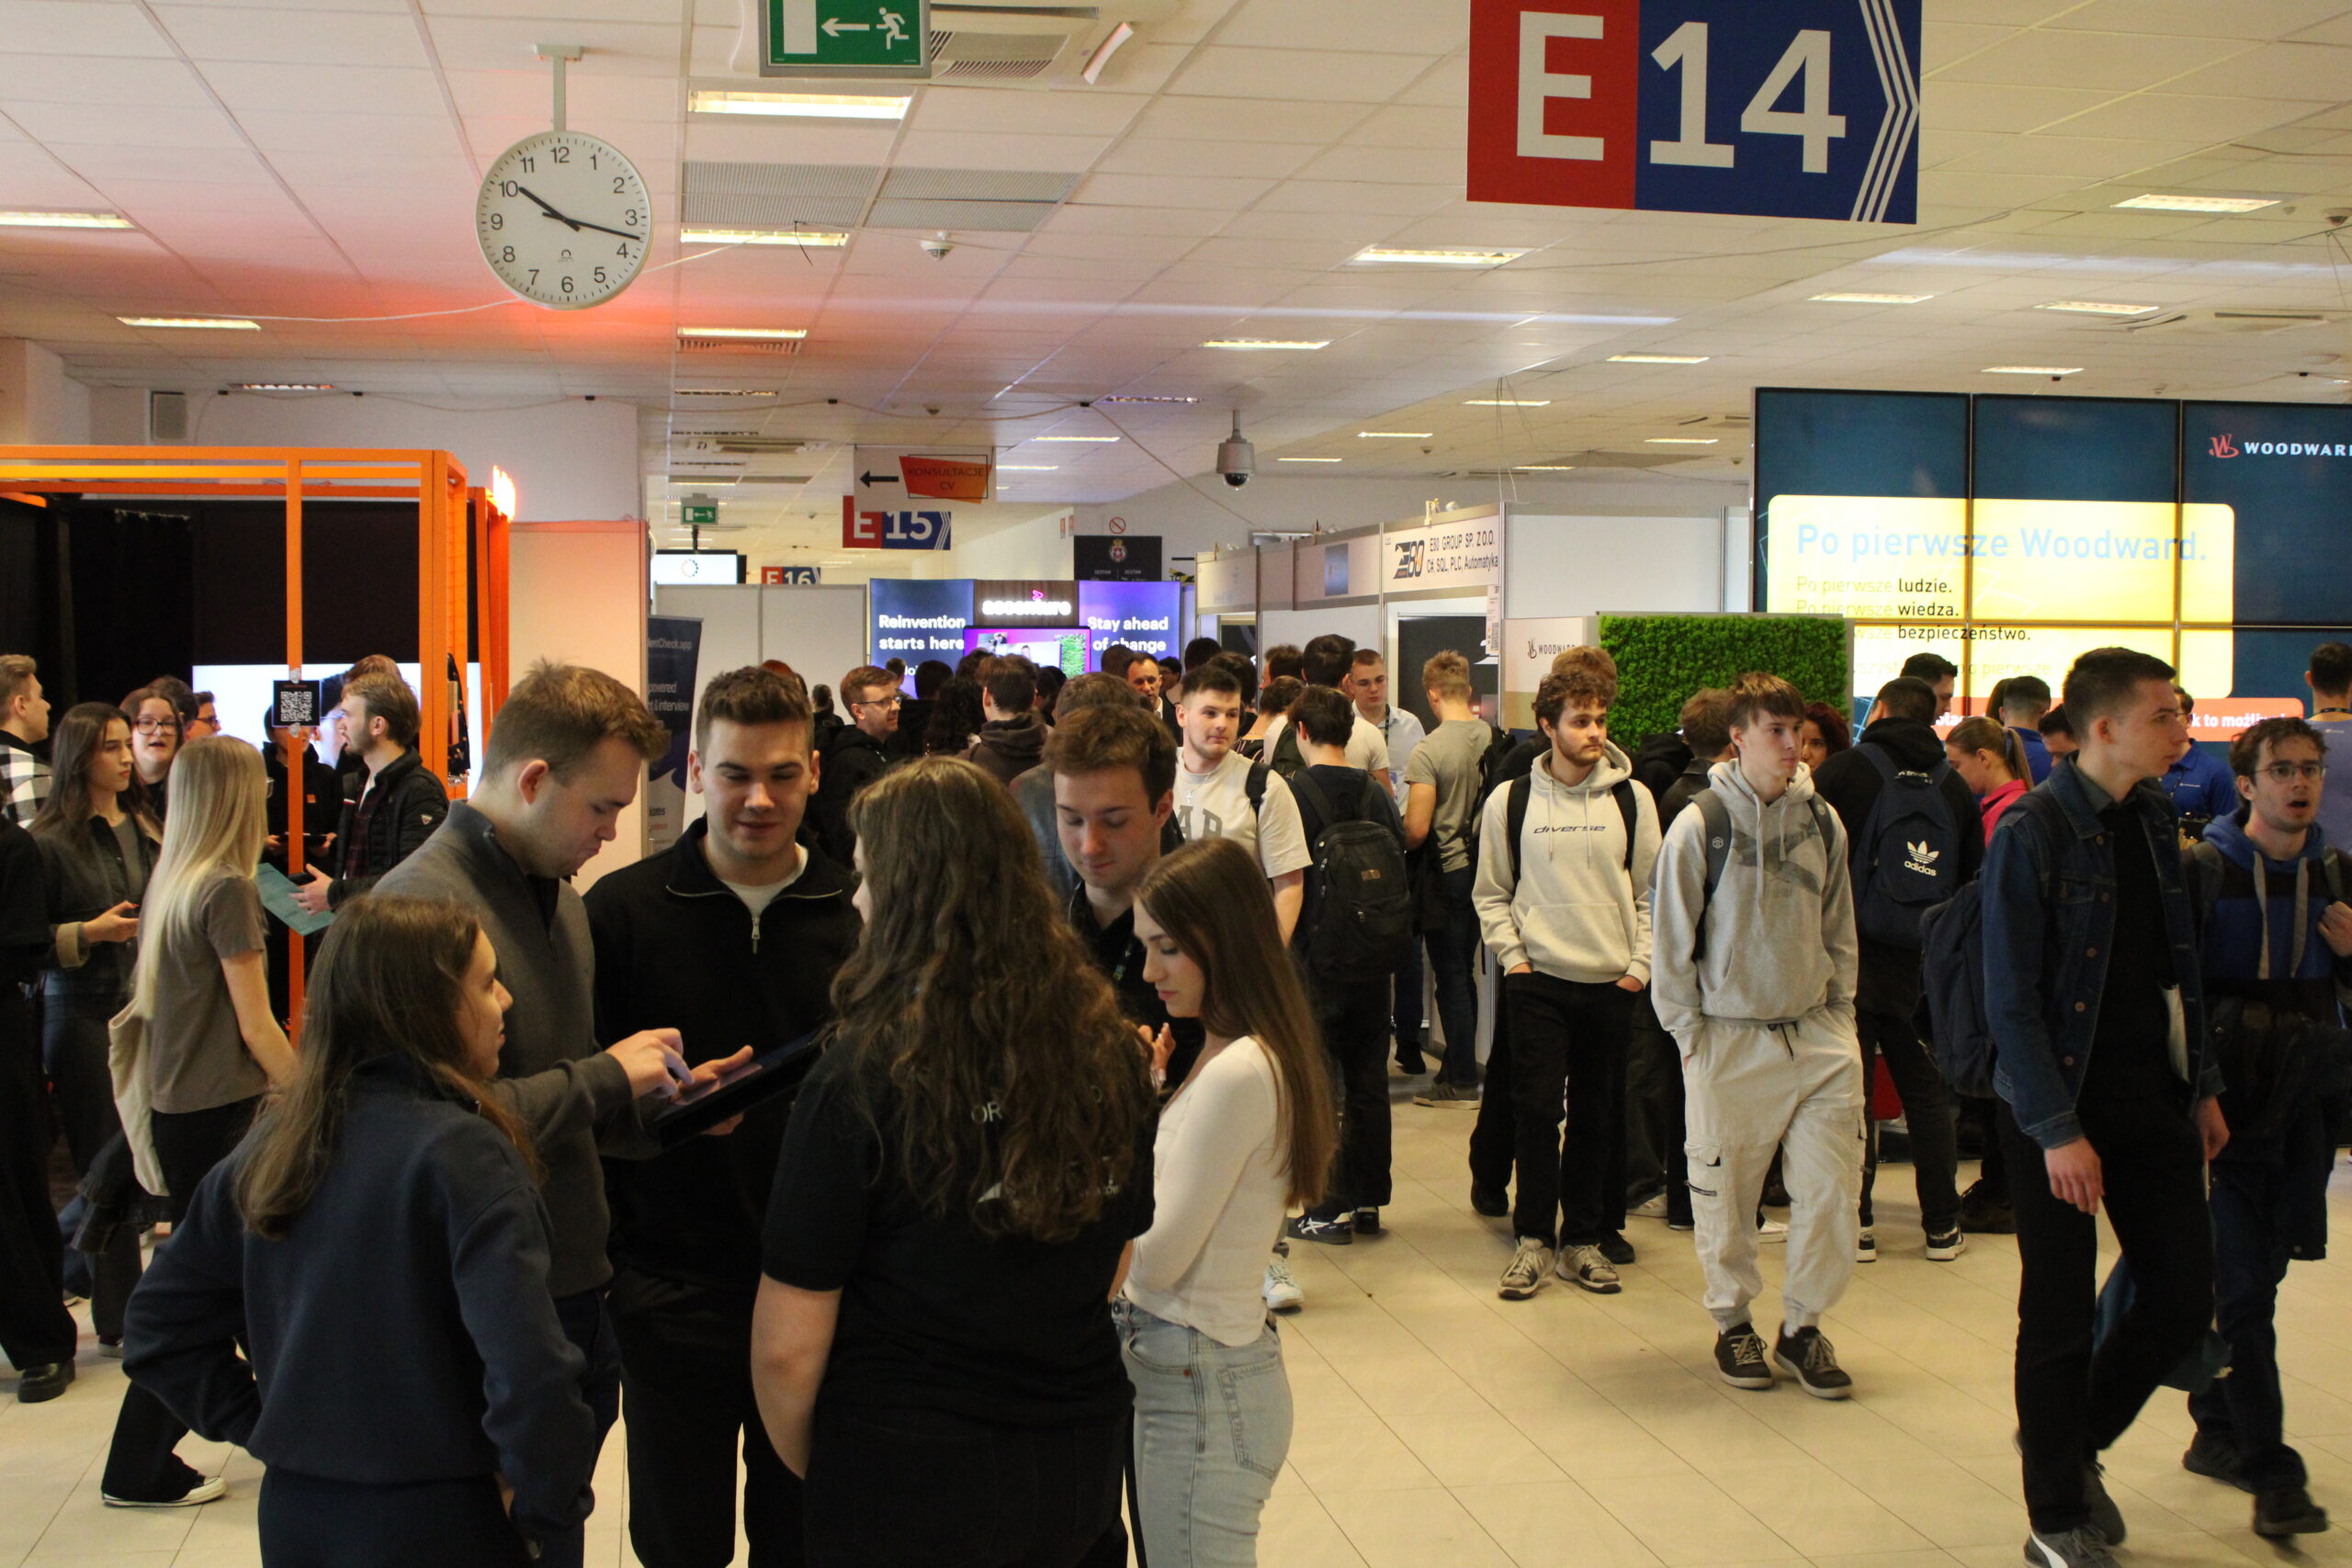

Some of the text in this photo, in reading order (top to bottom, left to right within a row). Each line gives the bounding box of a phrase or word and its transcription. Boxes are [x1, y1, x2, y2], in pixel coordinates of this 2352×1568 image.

[550, 147, 570, 164] 12
[590, 154, 597, 170] 1
[520, 157, 535, 173] 11
[498, 180, 519, 197] 10
[613, 177, 625, 194] 2
[491, 213, 503, 230] 9
[625, 209, 638, 226] 3
[503, 246, 515, 263] 8
[616, 243, 628, 258] 4
[528, 269, 539, 286] 7
[594, 266, 606, 283] 5
[561, 276, 574, 293] 6
[2244, 441, 2352, 457] WOODWAR
[1442, 534, 1463, 551] GROUP
[1797, 524, 2206, 563] Po pierwsze Woodward.
[1464, 552, 1498, 572] Automatyka
[1898, 578, 1952, 593] ludzie.
[1898, 602, 1959, 617] wiedza.
[878, 615, 966, 629] Reinvention
[1088, 616, 1169, 633] Stay ahead
[1898, 625, 2031, 642] bezpieczeństwo.
[878, 636, 965, 650] starts here
[1092, 637, 1109, 651] of
[1539, 644, 1575, 654] WOODWA
[2203, 714, 2219, 728] to
[1533, 825, 1606, 834] diverse
[1904, 861, 1937, 876] adidas
